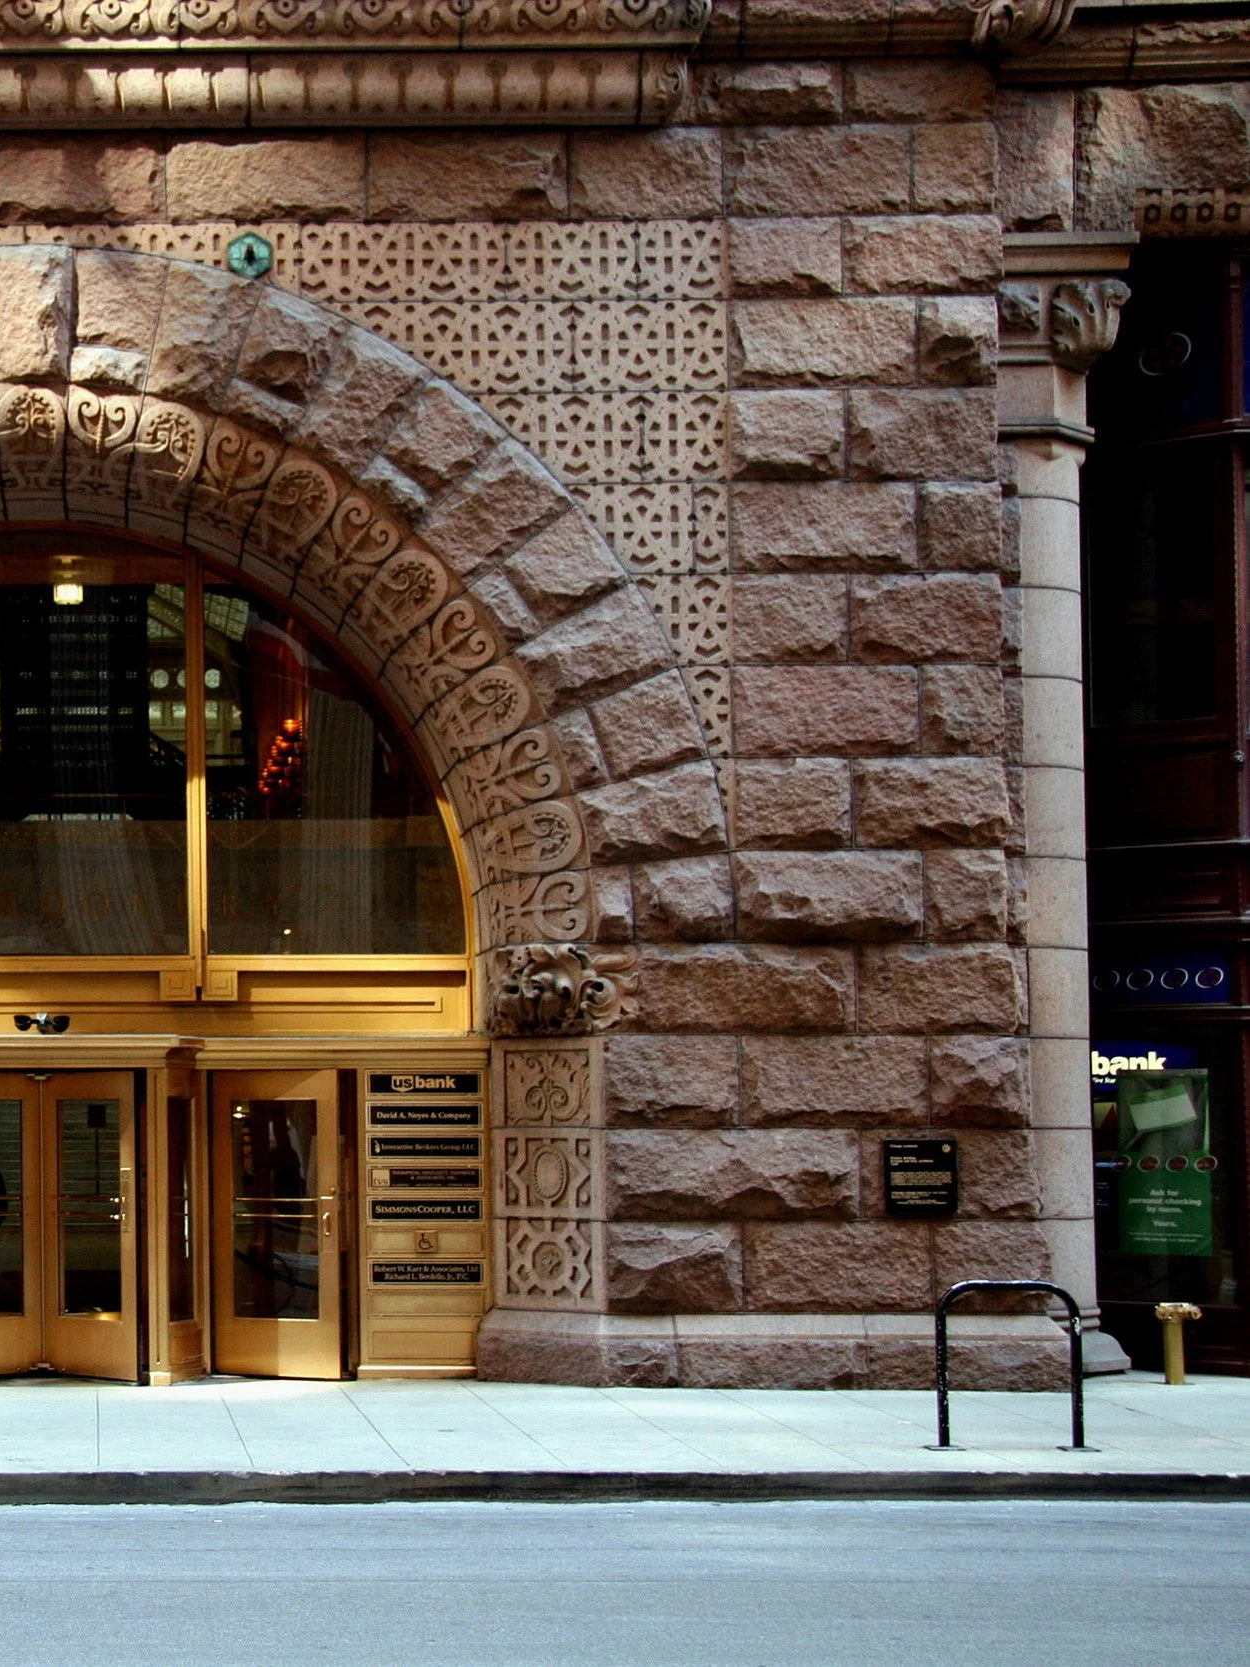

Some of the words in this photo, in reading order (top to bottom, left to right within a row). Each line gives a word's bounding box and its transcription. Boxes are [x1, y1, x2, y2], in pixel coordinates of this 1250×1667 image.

[1091, 1050, 1167, 1076] bank
[438, 1112, 472, 1120] Company
[457, 1205, 476, 1214] LLC
